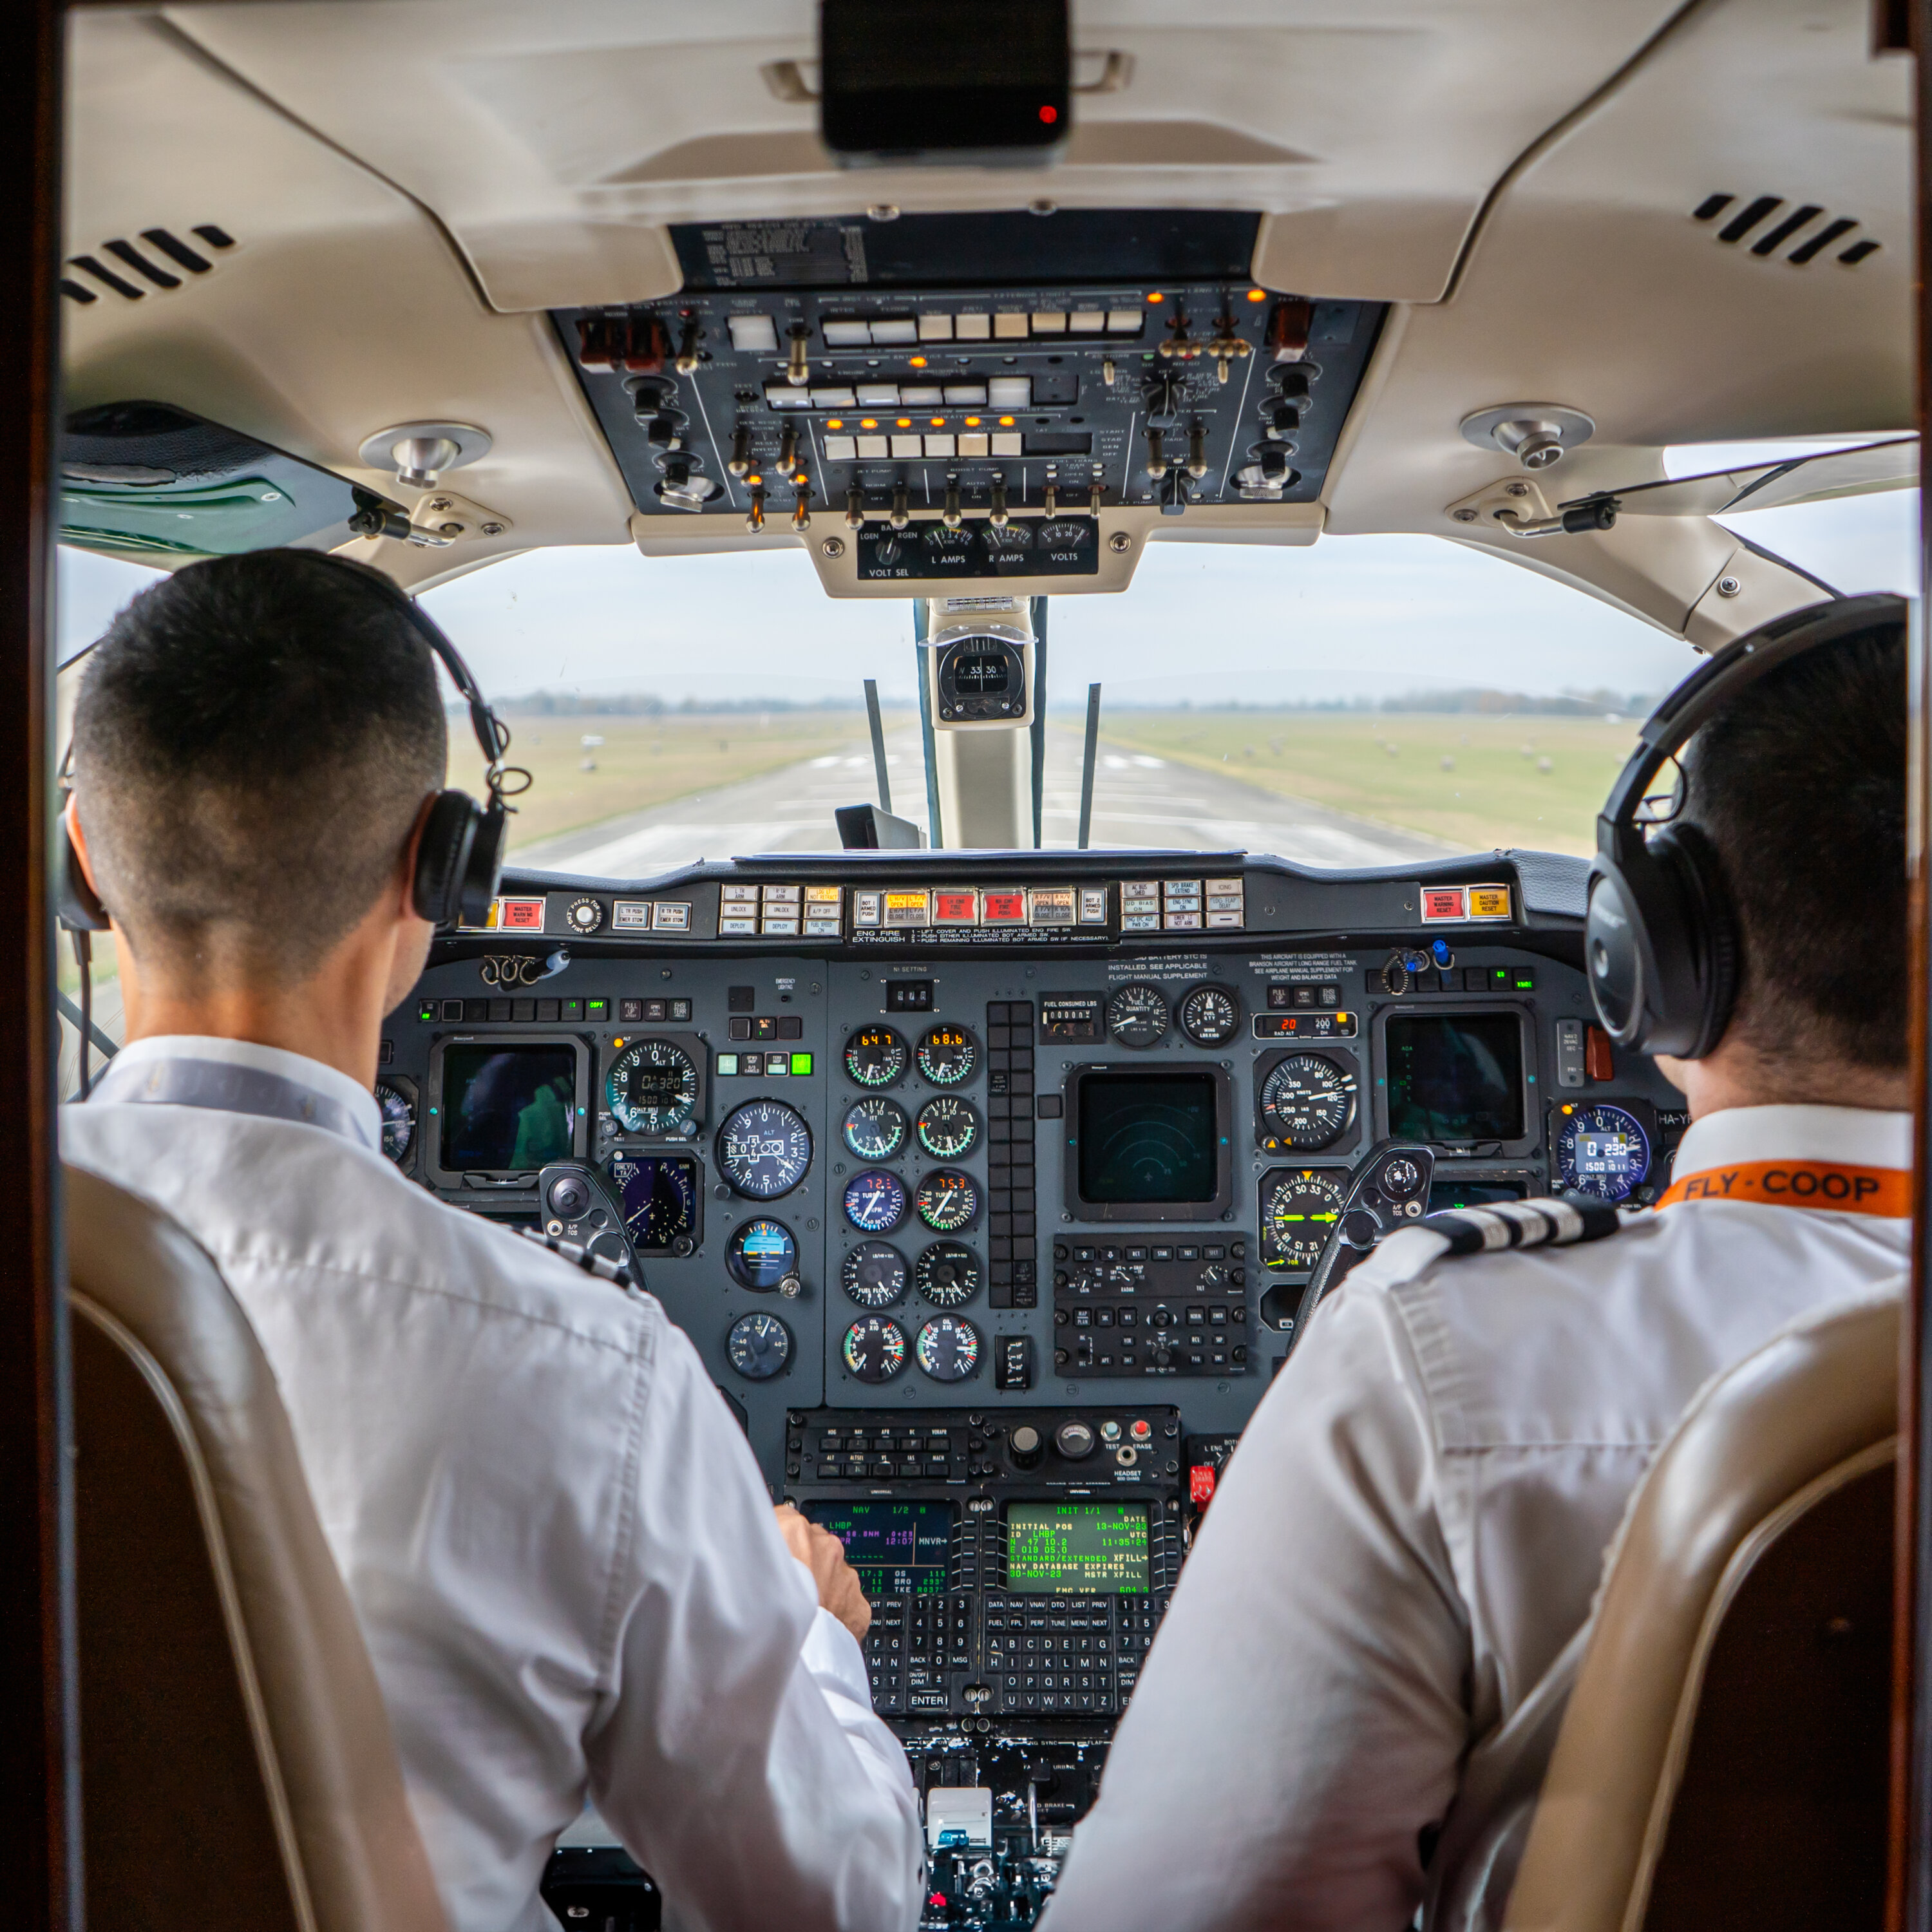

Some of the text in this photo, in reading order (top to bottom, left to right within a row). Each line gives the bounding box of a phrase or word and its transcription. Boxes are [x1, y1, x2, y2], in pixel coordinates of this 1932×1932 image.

[970, 666, 981, 674] 33
[985, 665, 996, 674] 30
[571, 898, 600, 933] PRESS FOR BELL
[1282, 1019, 1296, 1030] 20
[1586, 1162, 1605, 1171] 1500
[1295, 1184, 1307, 1195] 30
[1309, 1184, 1321, 1195] 33
[1684, 1171, 1739, 1201] FLY
[1762, 1170, 1879, 1201] COOP
[1045, 1538, 1067, 1546] 10.2
[1102, 1538, 1147, 1546] 11:35:24
[1044, 1546, 1067, 1554] 05.0
[1010, 1570, 1062, 1578] 30-NOV-23
[911, 1696, 943, 1705] ENTER
